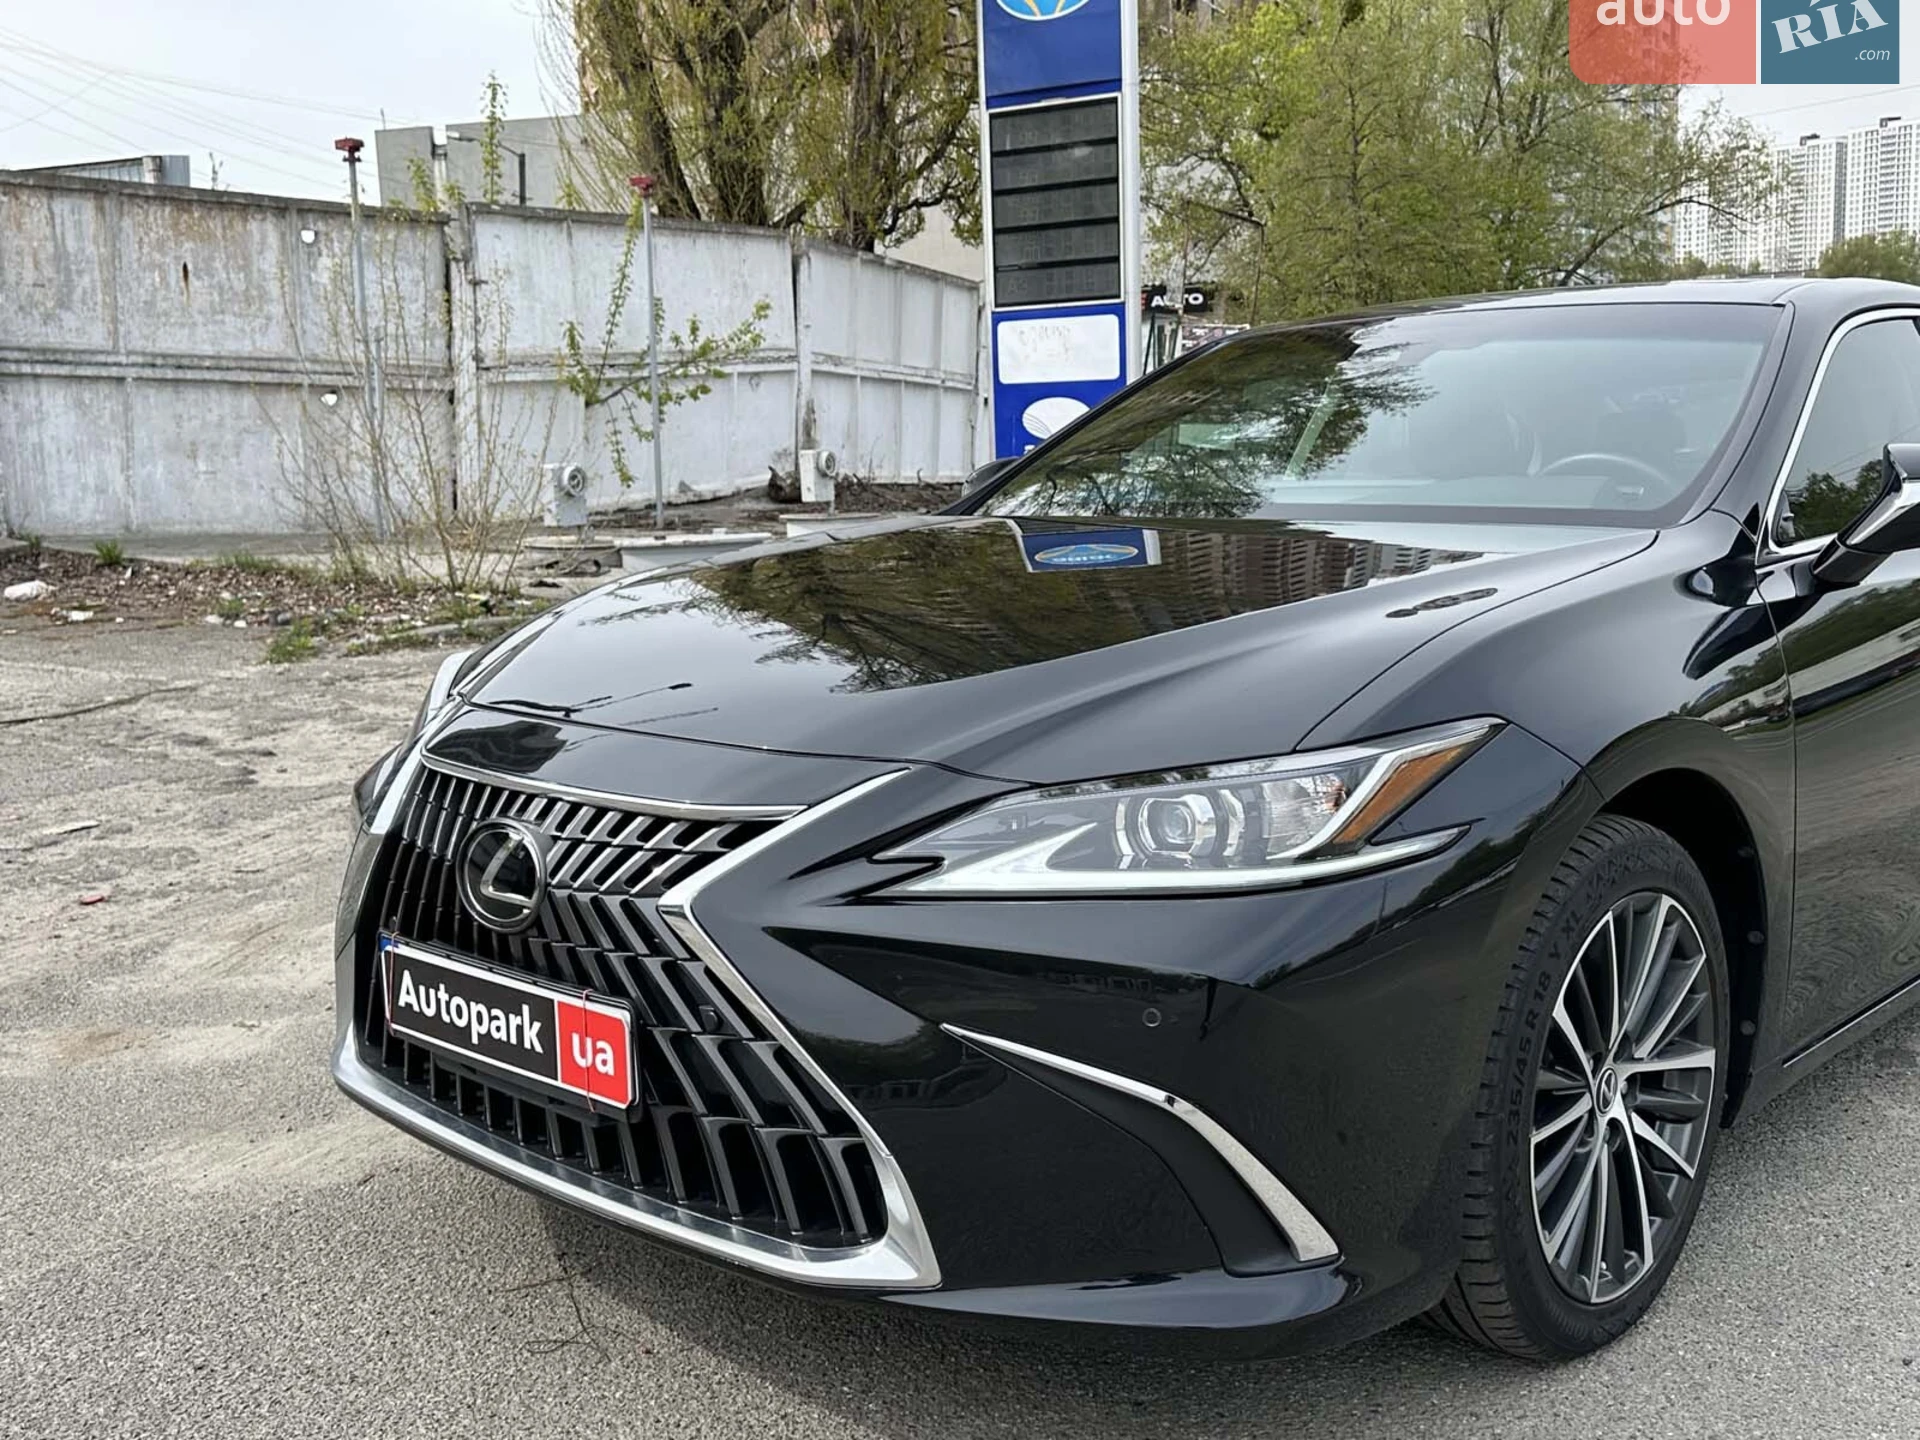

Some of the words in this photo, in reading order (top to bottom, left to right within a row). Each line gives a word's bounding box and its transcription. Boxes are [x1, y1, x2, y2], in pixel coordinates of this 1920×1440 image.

[398, 969, 544, 1053] Autopark
[571, 1032, 615, 1076] ua
[1507, 1036, 1532, 1145] 235/45
